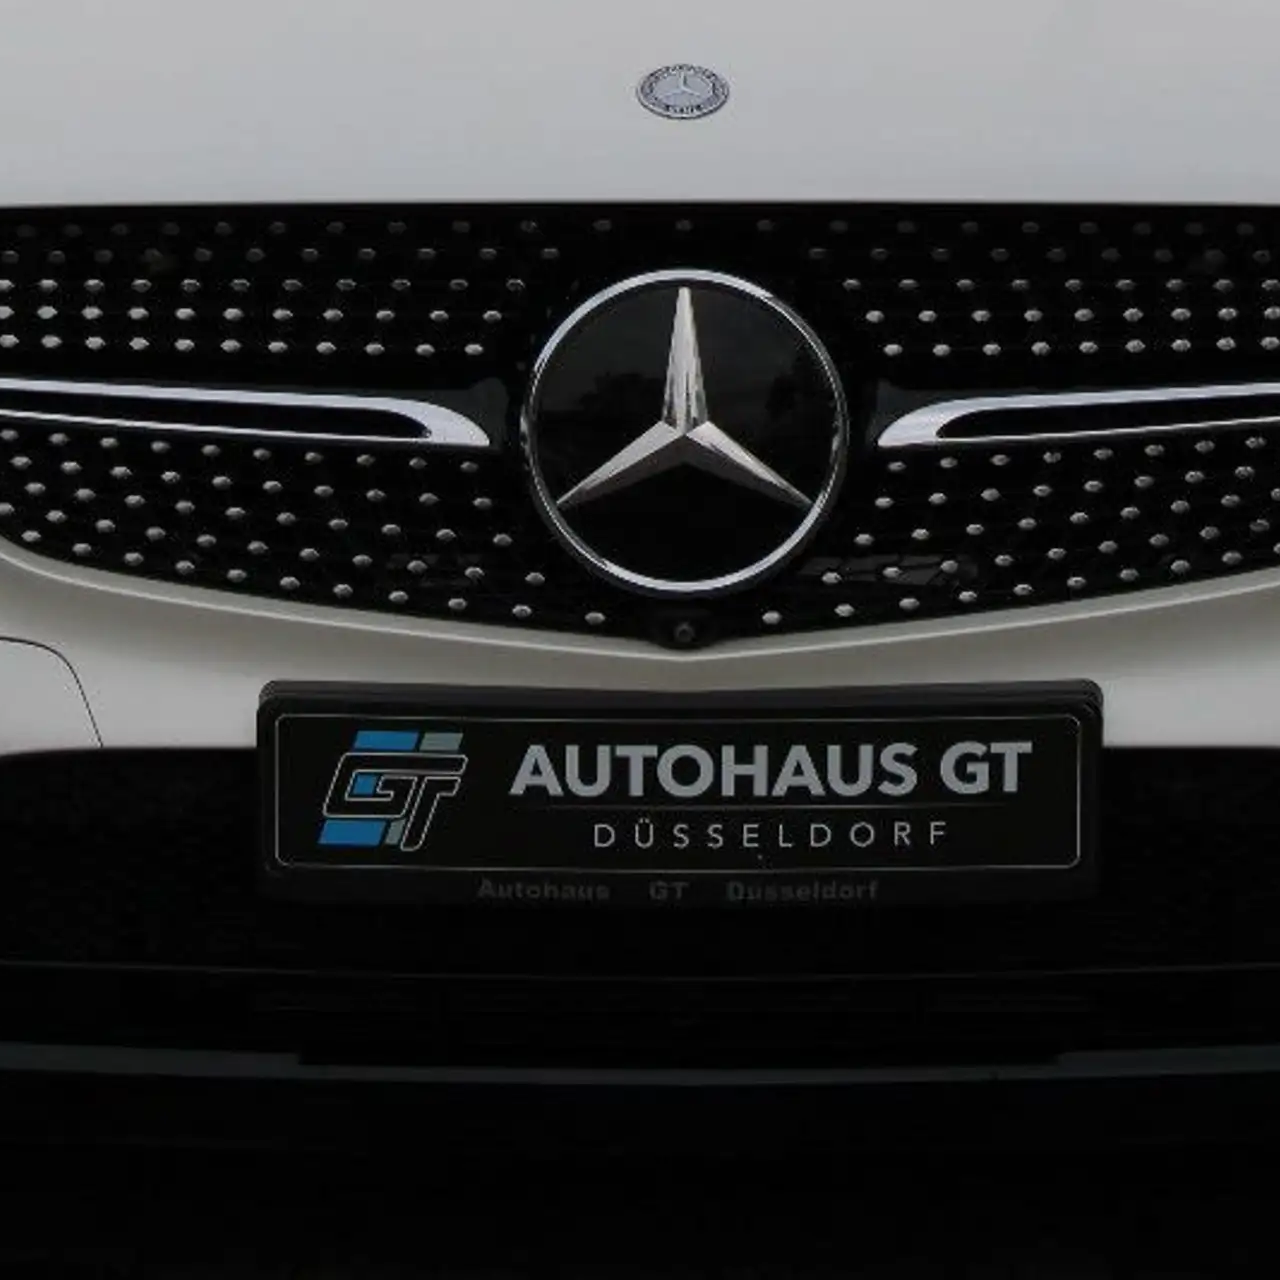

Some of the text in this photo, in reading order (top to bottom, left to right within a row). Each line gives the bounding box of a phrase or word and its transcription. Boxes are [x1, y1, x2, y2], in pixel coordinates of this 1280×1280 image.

[509, 740, 1034, 799] AUTOHAUS GT
[593, 817, 947, 849] DÜSSELDORF
[476, 878, 611, 901] Autohaus
[647, 880, 690, 901] GT
